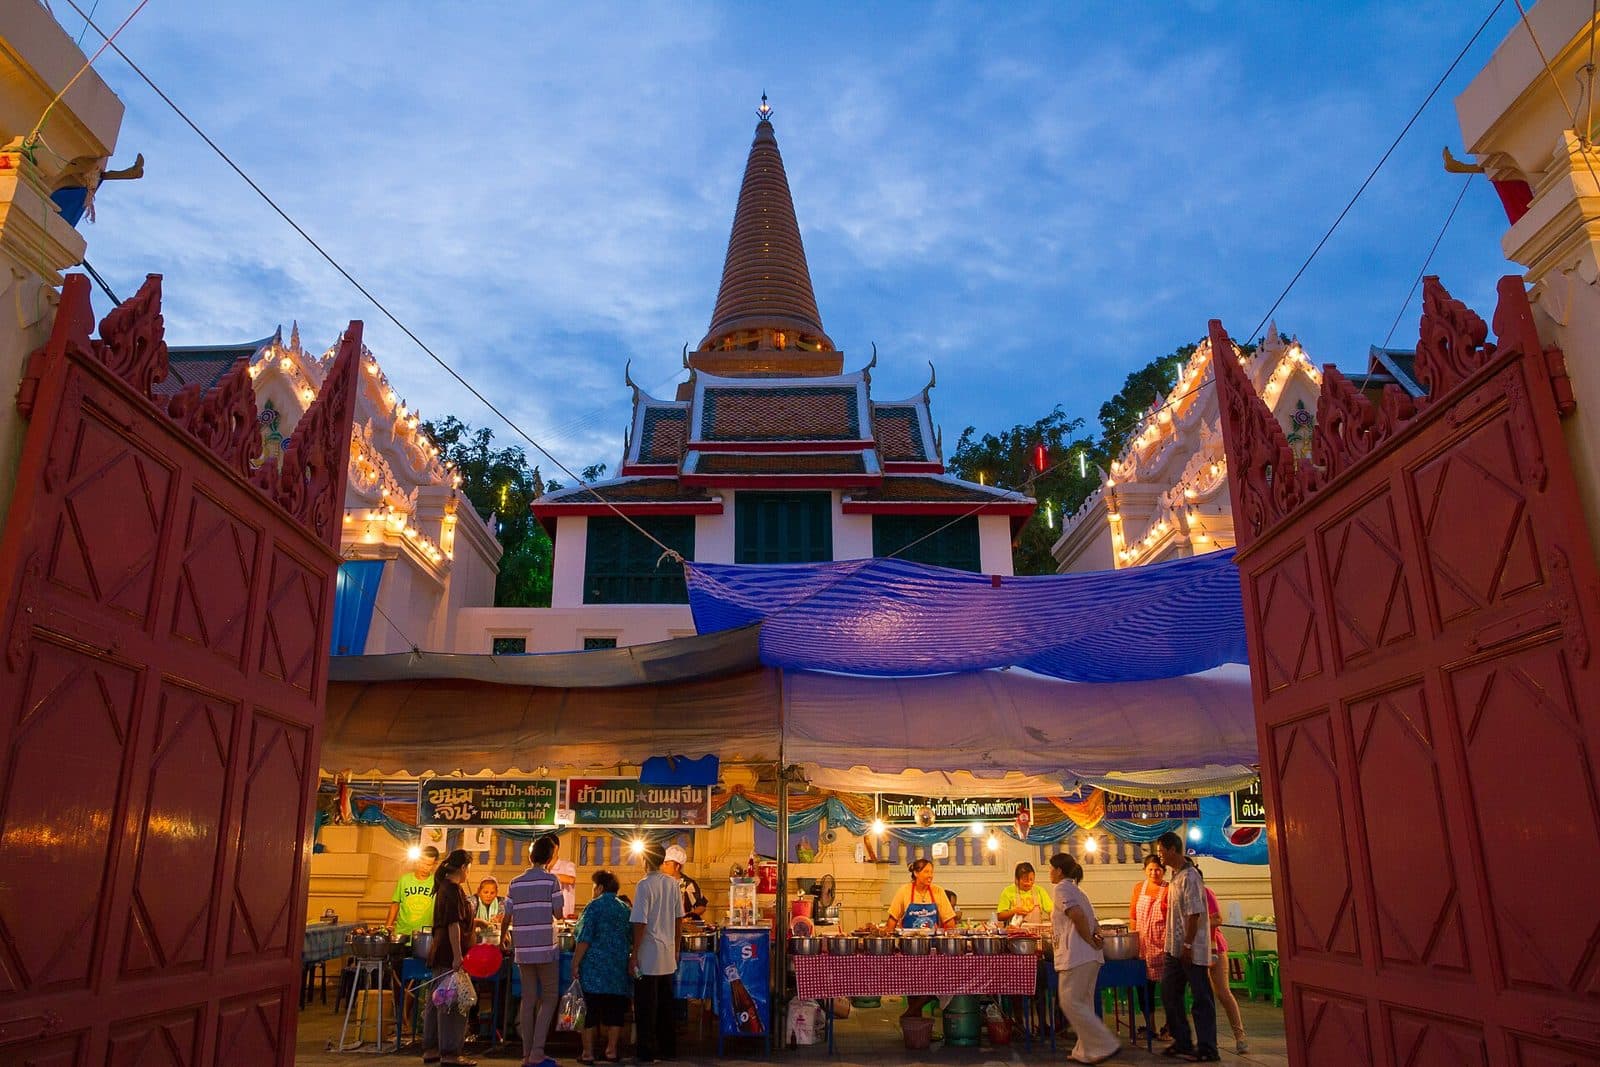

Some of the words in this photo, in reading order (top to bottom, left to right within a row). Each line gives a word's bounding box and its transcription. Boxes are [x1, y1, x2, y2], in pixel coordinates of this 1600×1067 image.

[428, 787, 473, 805] ขนม
[577, 785, 635, 804] ข้าวแกง
[648, 785, 702, 804] ขนมจีน
[435, 803, 471, 821] จีน
